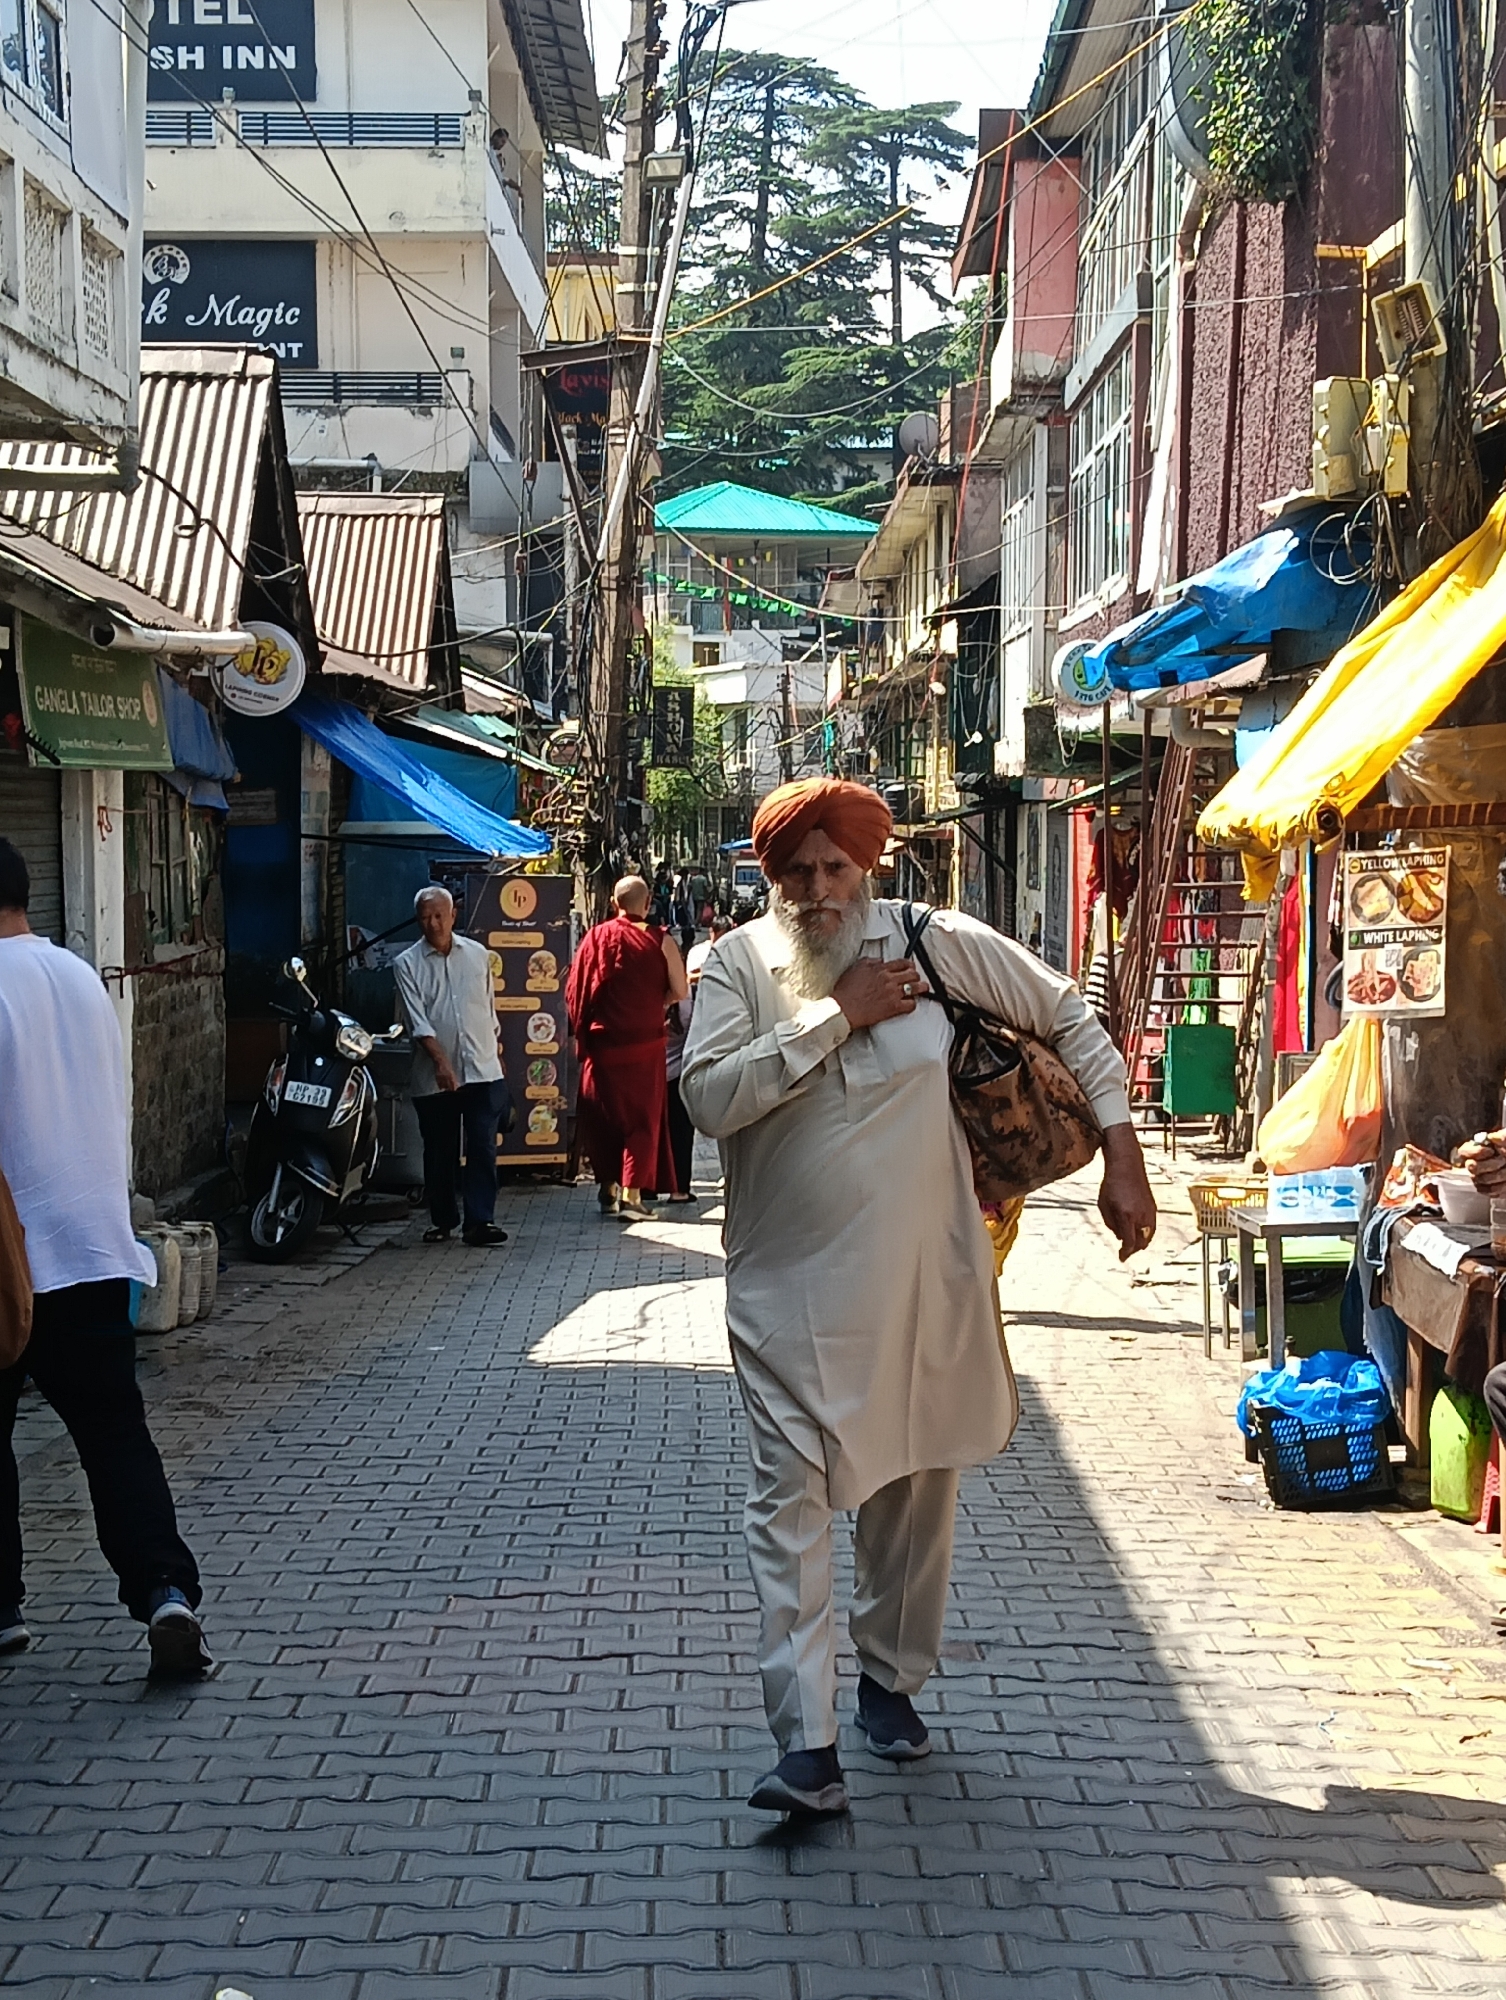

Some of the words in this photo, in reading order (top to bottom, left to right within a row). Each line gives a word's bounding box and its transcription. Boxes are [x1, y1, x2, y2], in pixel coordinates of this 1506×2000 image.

[149, 45, 204, 70] SH
[222, 45, 296, 69] INN
[141, 287, 170, 324] k
[185, 294, 300, 337] Magic
[35, 685, 80, 716] GANGLA
[80, 691, 117, 718] TAILOR
[117, 696, 141, 720] SHOP
[666, 692, 681, 753] ASHOKA
[1362, 858, 1398, 870] YELLOW
[1402, 854, 1443, 867] LAPHING
[1363, 931, 1394, 945] WHITE
[1396, 929, 1440, 942] LAPHING
